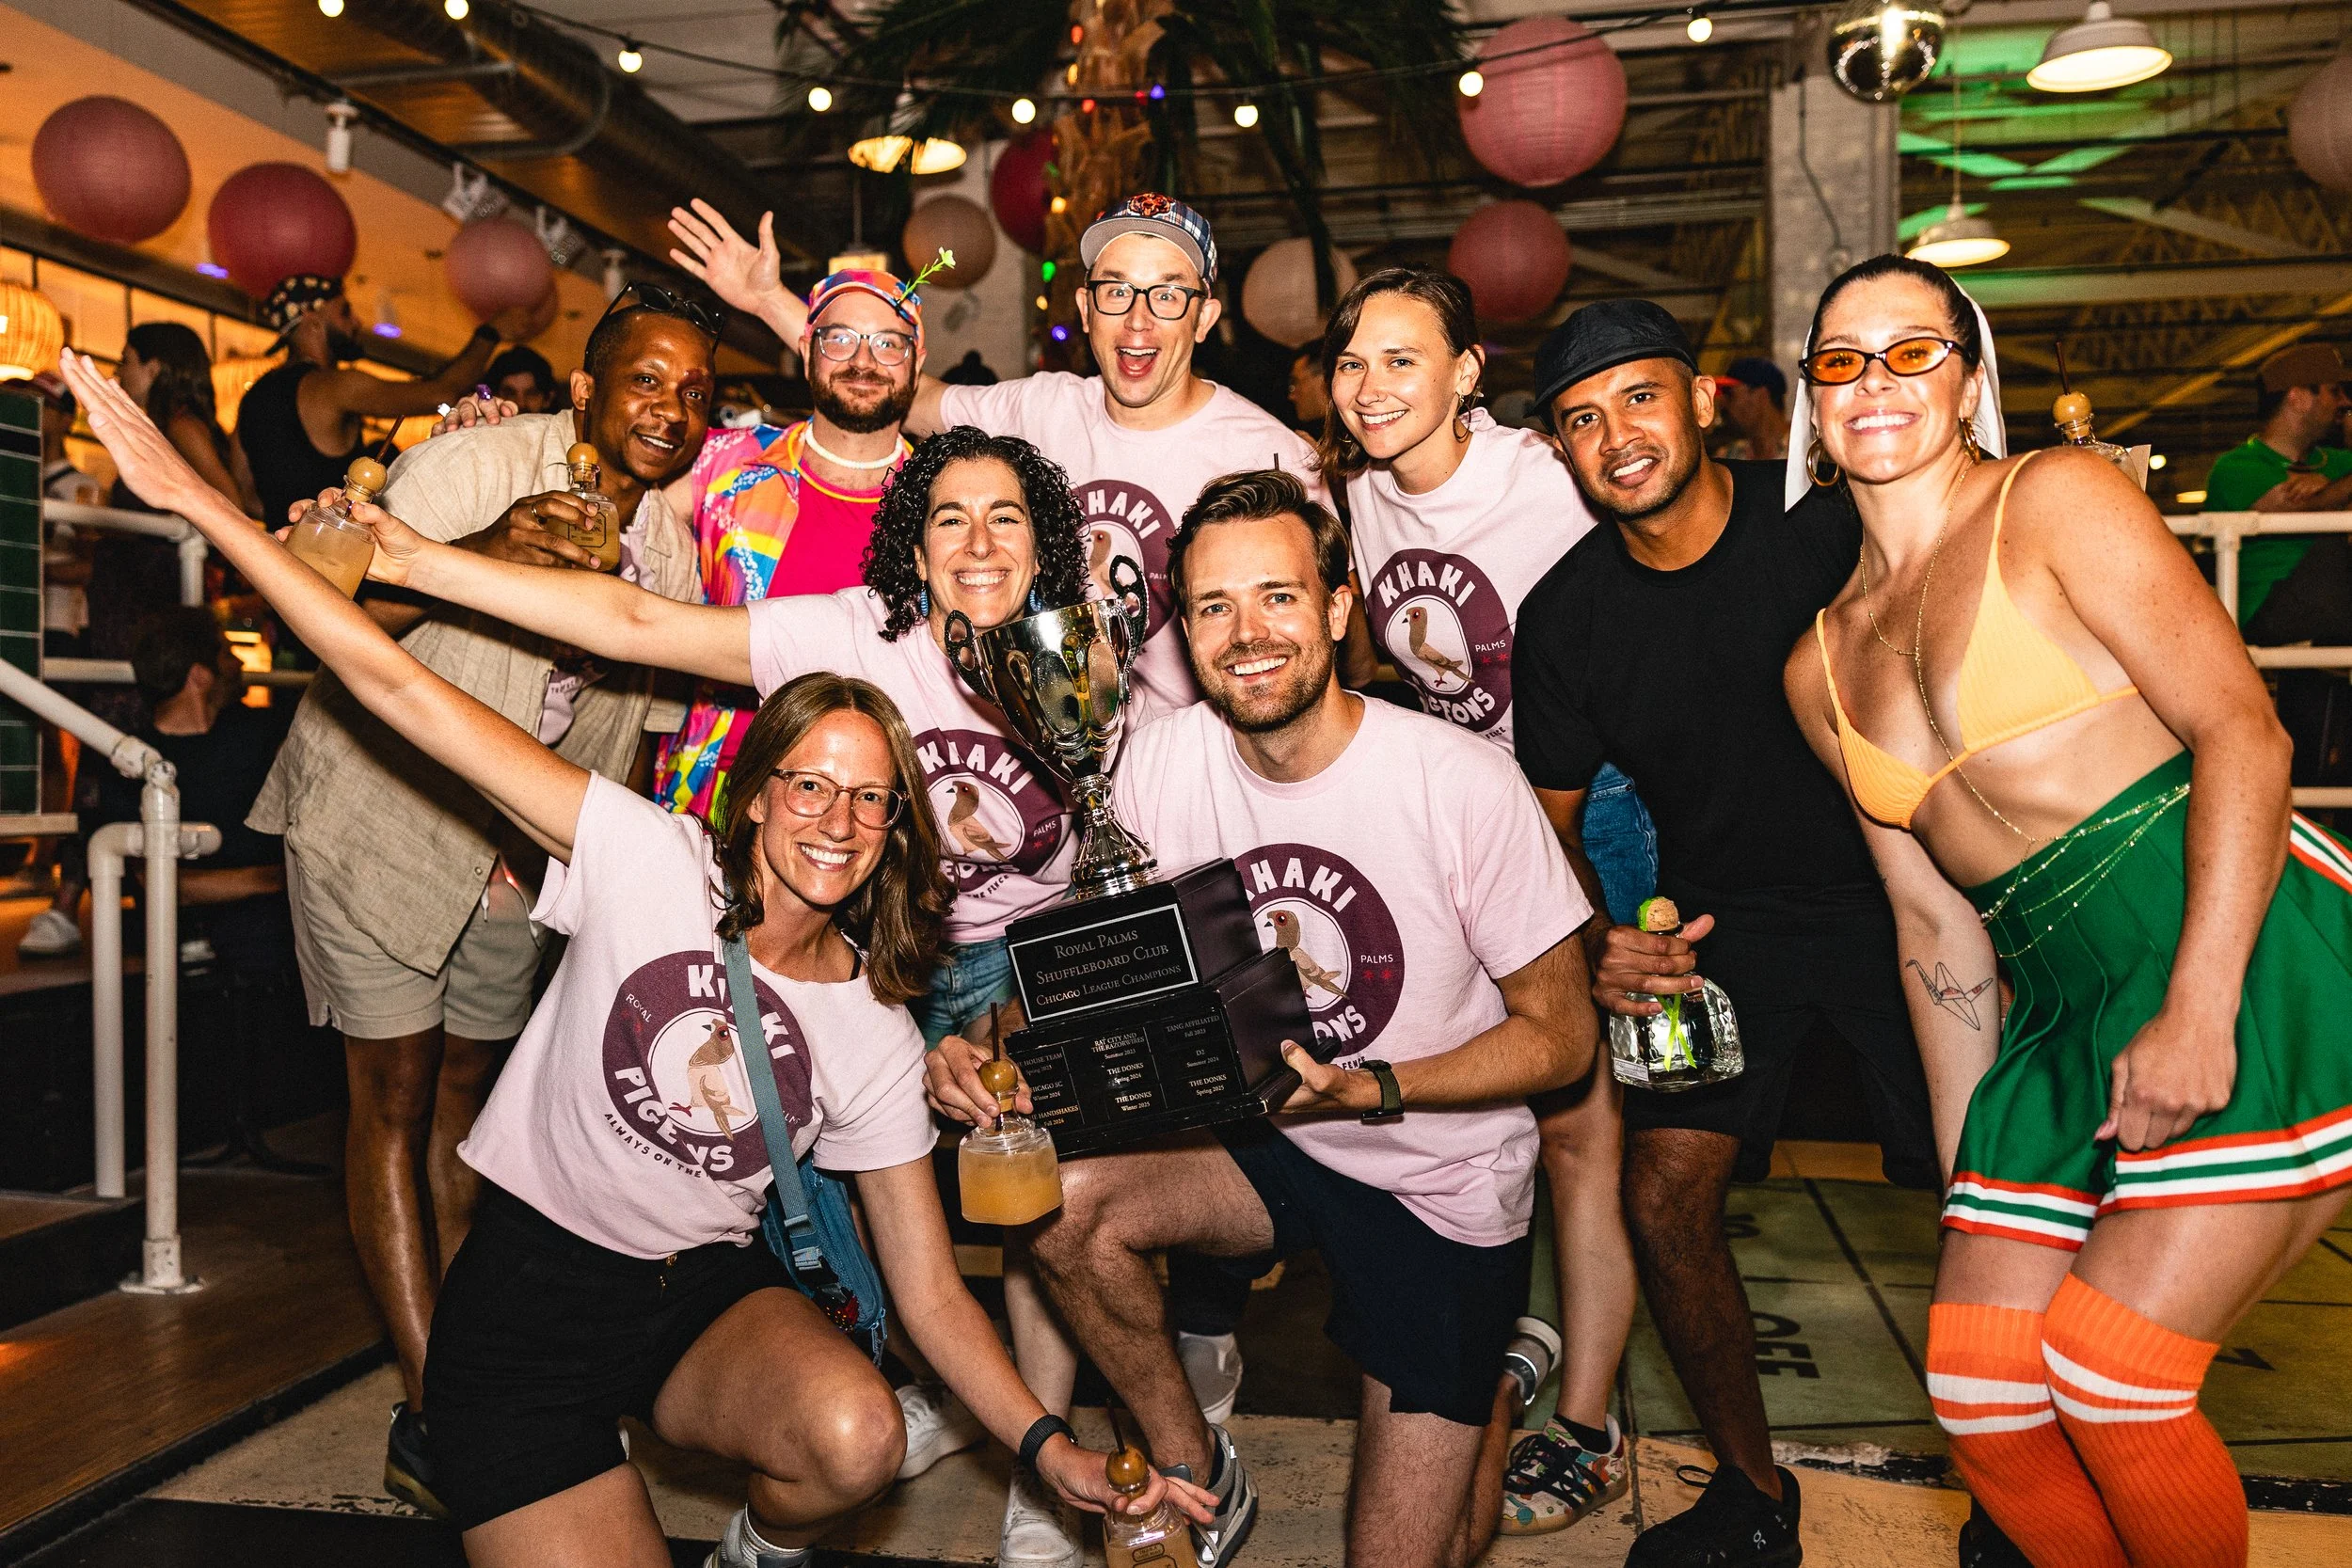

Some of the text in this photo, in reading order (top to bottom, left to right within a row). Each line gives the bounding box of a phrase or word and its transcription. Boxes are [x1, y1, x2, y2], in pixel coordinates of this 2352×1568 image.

[1083, 488, 1162, 540] HAKI
[1149, 572, 1168, 580] PALM
[1377, 561, 1476, 609] KHAKI
[1475, 640, 1506, 653] PALMS
[1033, 820, 1057, 836] PALMS
[1248, 857, 1358, 913] HAKI
[1055, 930, 1138, 958] ROYAL PALMS
[1036, 944, 1168, 985] SHUFFLEBOARD CLUB
[1360, 954, 1394, 964] PALMS
[1036, 965, 1182, 1006] CHICAGO LEAGUE CHAMPIONS
[626, 993, 652, 1022] ROYAL
[1166, 1016, 1220, 1032] TANG AFFILIATED
[1094, 1037, 1106, 1047] RAT
[1107, 1036, 1122, 1044] CITY
[1024, 1055, 1045, 1066] HOUSE
[1045, 1053, 1063, 1061] TEAM
[1121, 1062, 1144, 1072] DONKS
[1031, 1083, 1054, 1092] HICAGO
[1188, 1074, 1227, 1087] THE DONKS
[1115, 1091, 1152, 1103] THE DONKS
[1039, 1105, 1079, 1118] HANDSHAKES
[605, 1114, 650, 1154] ALWAYS
[654, 1153, 672, 1165] ON
[677, 1163, 702, 1178] THE
